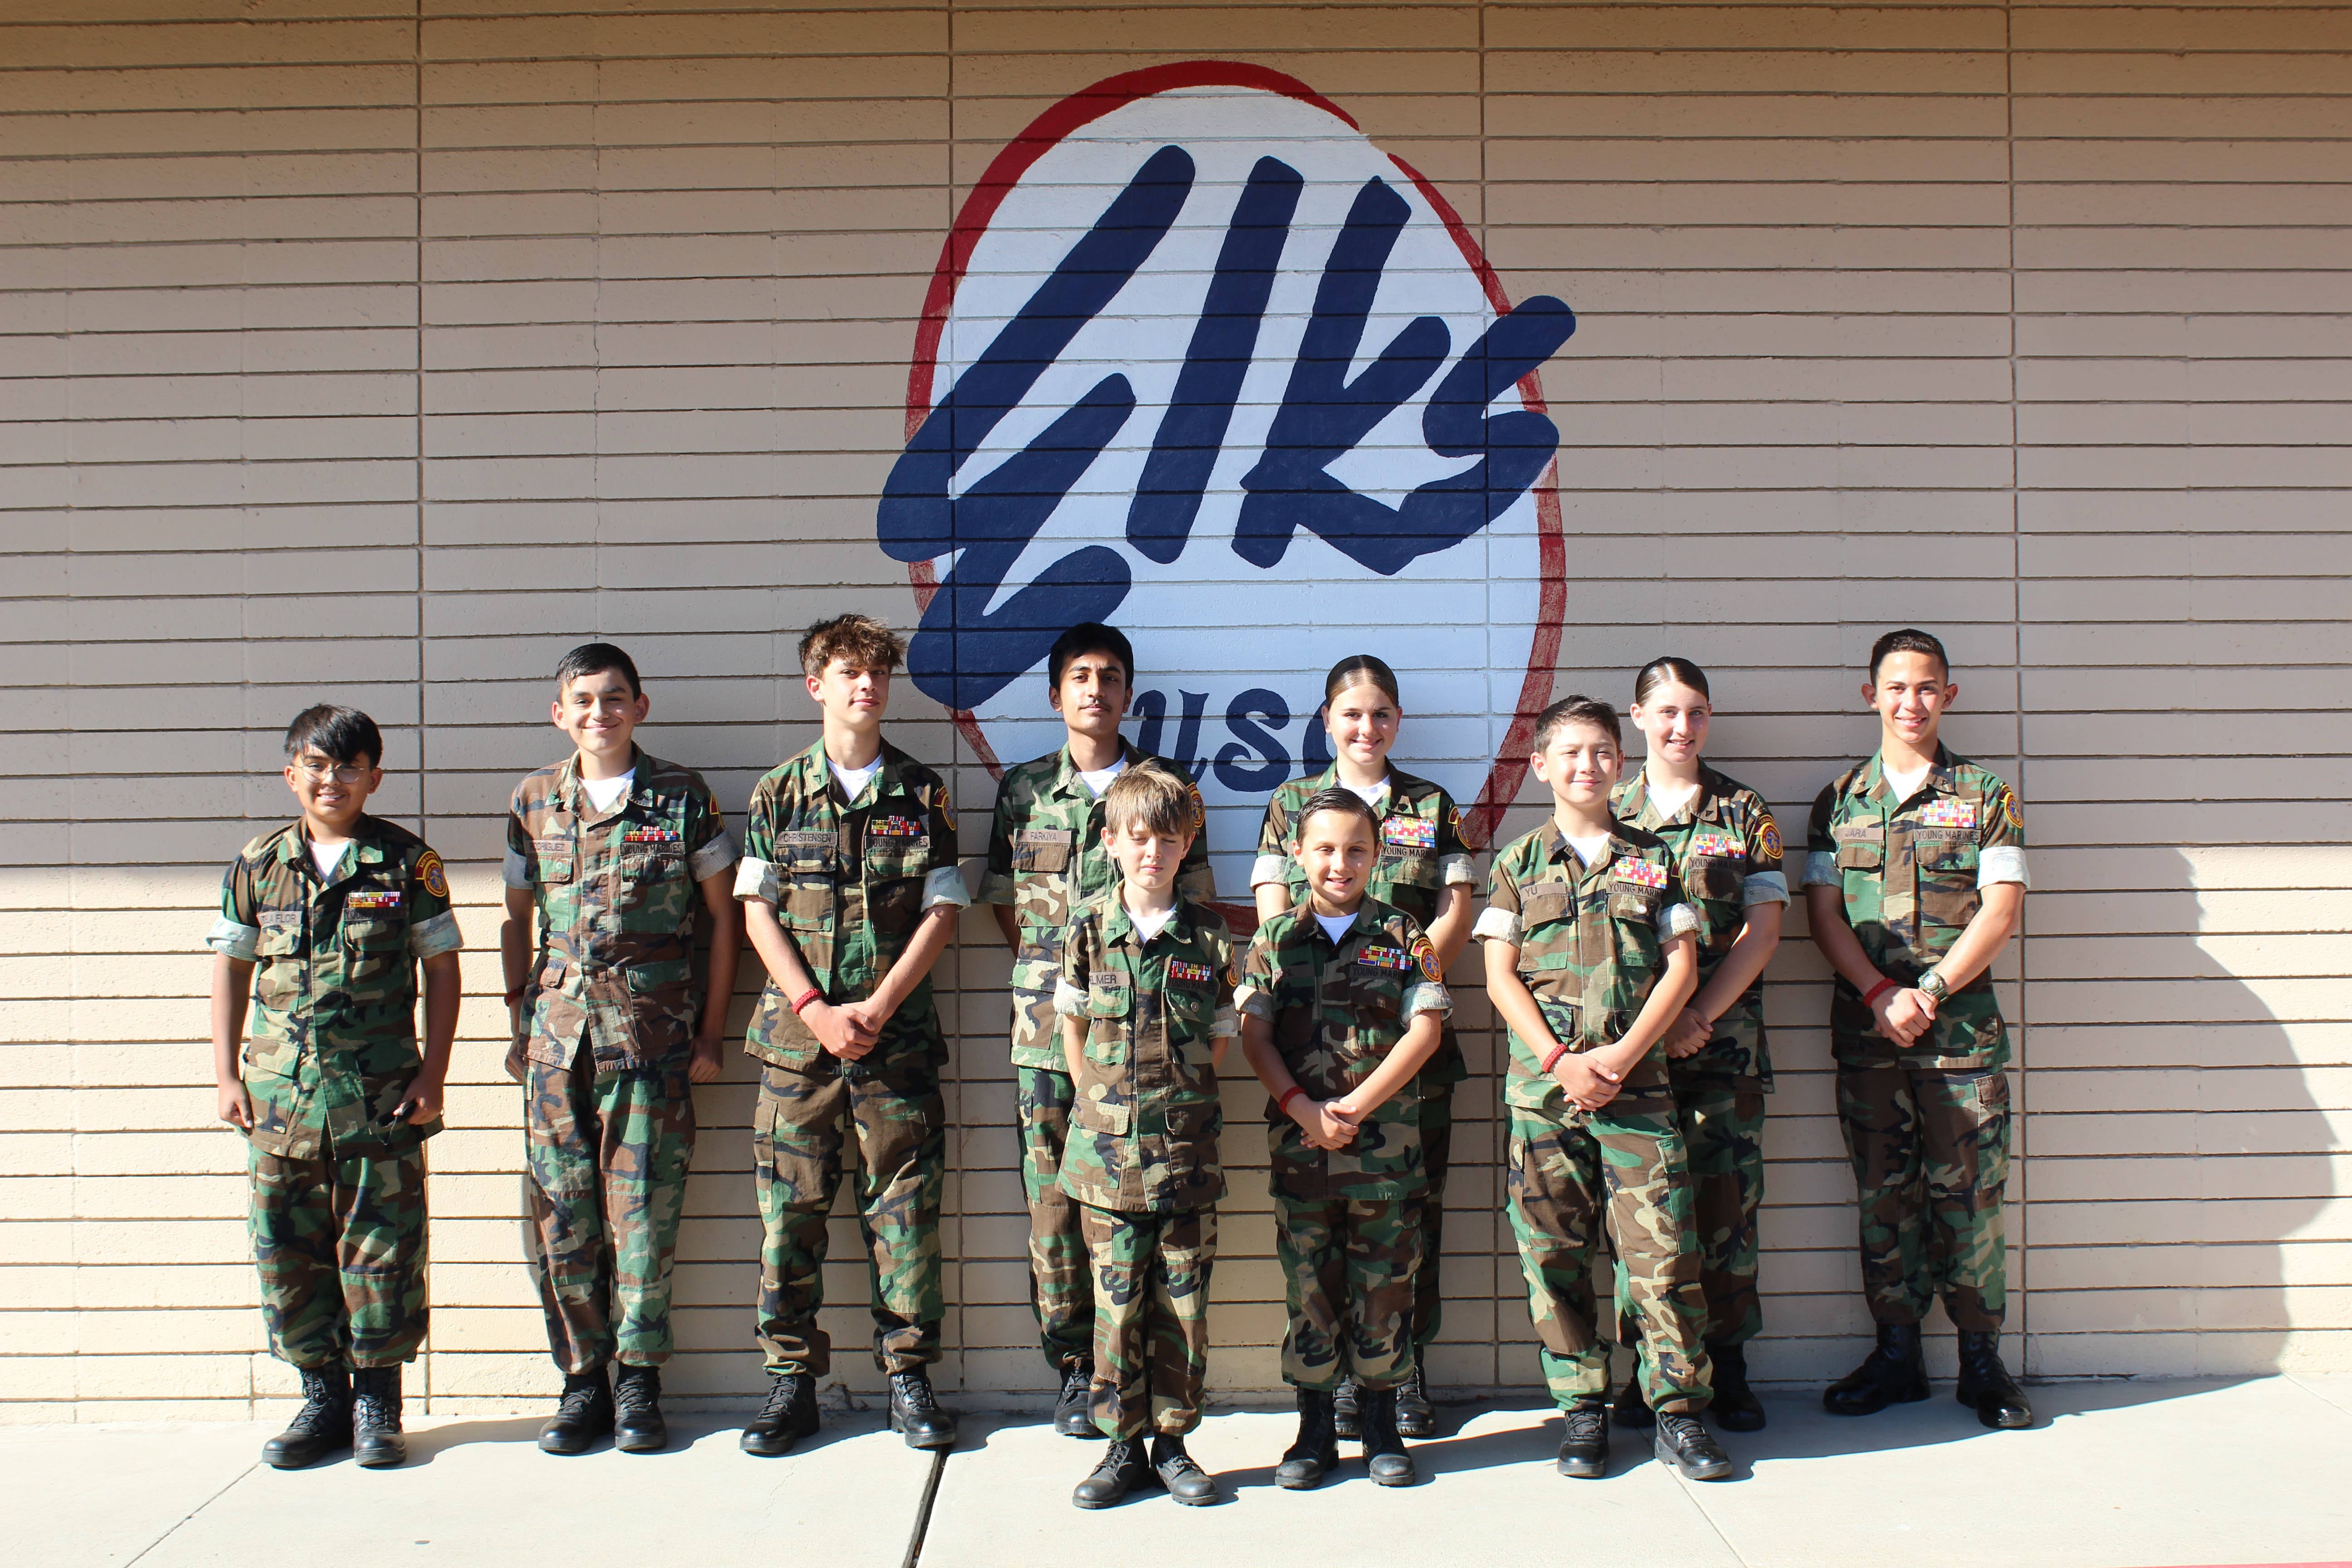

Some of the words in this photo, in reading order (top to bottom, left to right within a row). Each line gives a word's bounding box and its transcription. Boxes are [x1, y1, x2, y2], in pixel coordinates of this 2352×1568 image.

[877, 145, 1576, 710] Elks
[784, 833, 831, 843] CHRISTENSEN
[1030, 832, 1057, 841] FARKIYA
[1845, 829, 1866, 838] JARA
[1916, 830, 1942, 839] YOUNG
[1945, 831, 1979, 840] MARINES
[530, 842, 565, 852] RODRIGUEZ
[868, 838, 893, 847] YOUNG
[895, 838, 928, 847] MARINES
[622, 844, 647, 853] YOUNG
[650, 844, 682, 853] MARINES
[1382, 846, 1407, 856] YOUNG
[1690, 858, 1715, 867] YOUNG
[1525, 886, 1538, 897] YU
[1608, 883, 1636, 892] YOUNG
[1638, 886, 1661, 897] MARIN
[1352, 966, 1378, 977] YOUNG
[1168, 976, 1191, 989] YOUNG
